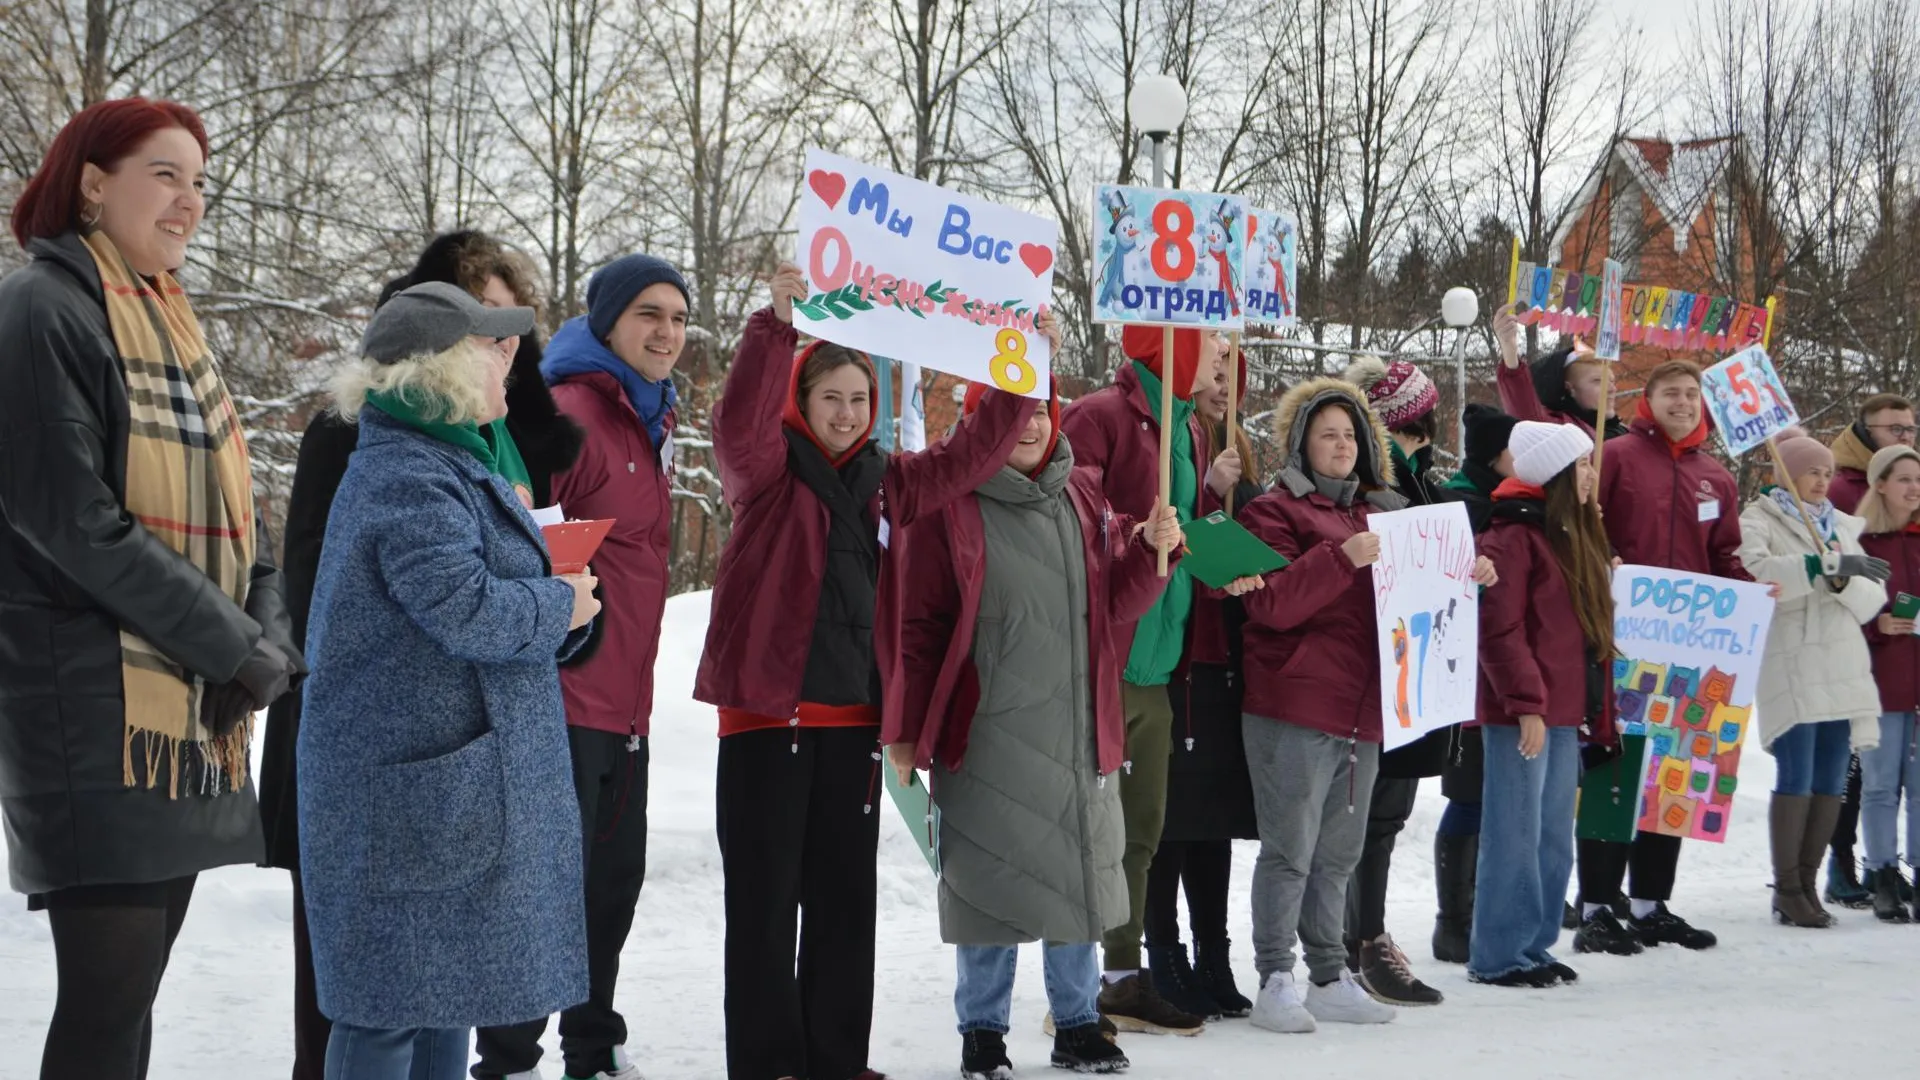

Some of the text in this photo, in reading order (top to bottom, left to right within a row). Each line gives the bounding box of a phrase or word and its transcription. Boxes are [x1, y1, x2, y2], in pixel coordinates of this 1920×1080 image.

[848, 177, 1013, 264] Мы Вас
[1150, 199, 1196, 282] 8
[809, 226, 935, 313] Очень
[1517, 267, 1597, 306] ДОБРО
[1121, 284, 1226, 320] отряд
[989, 328, 1036, 394] 8
[1726, 362, 1760, 415] 5
[1735, 406, 1787, 442] отряд
[1614, 616, 1759, 655] ожаловать!
